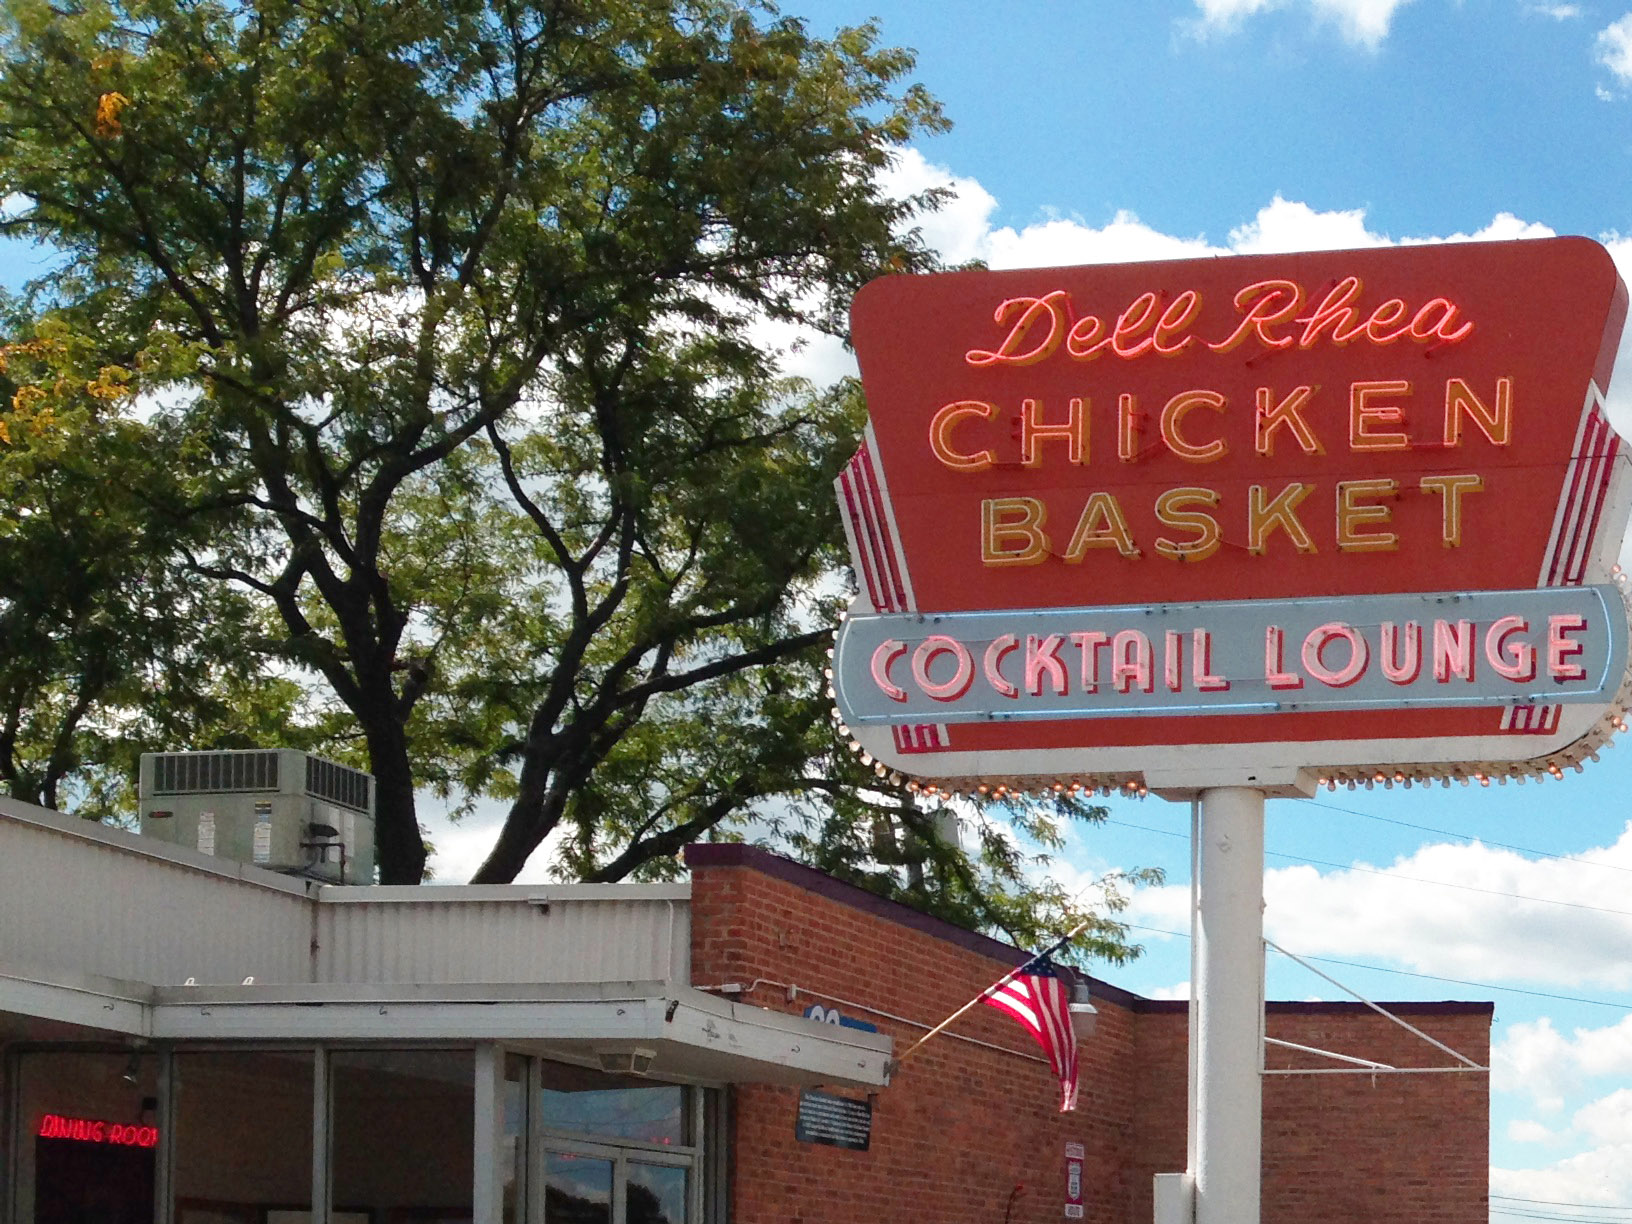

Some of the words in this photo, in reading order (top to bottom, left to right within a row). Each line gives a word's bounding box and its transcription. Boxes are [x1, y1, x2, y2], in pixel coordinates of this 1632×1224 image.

[965, 288, 1200, 368] Dell
[1205, 275, 1474, 362] Rhea
[928, 376, 1515, 471] CHICKEN
[980, 474, 1484, 566] BASKET
[871, 627, 1233, 703] COCKTAIL
[1265, 614, 1587, 692] LOUNGE
